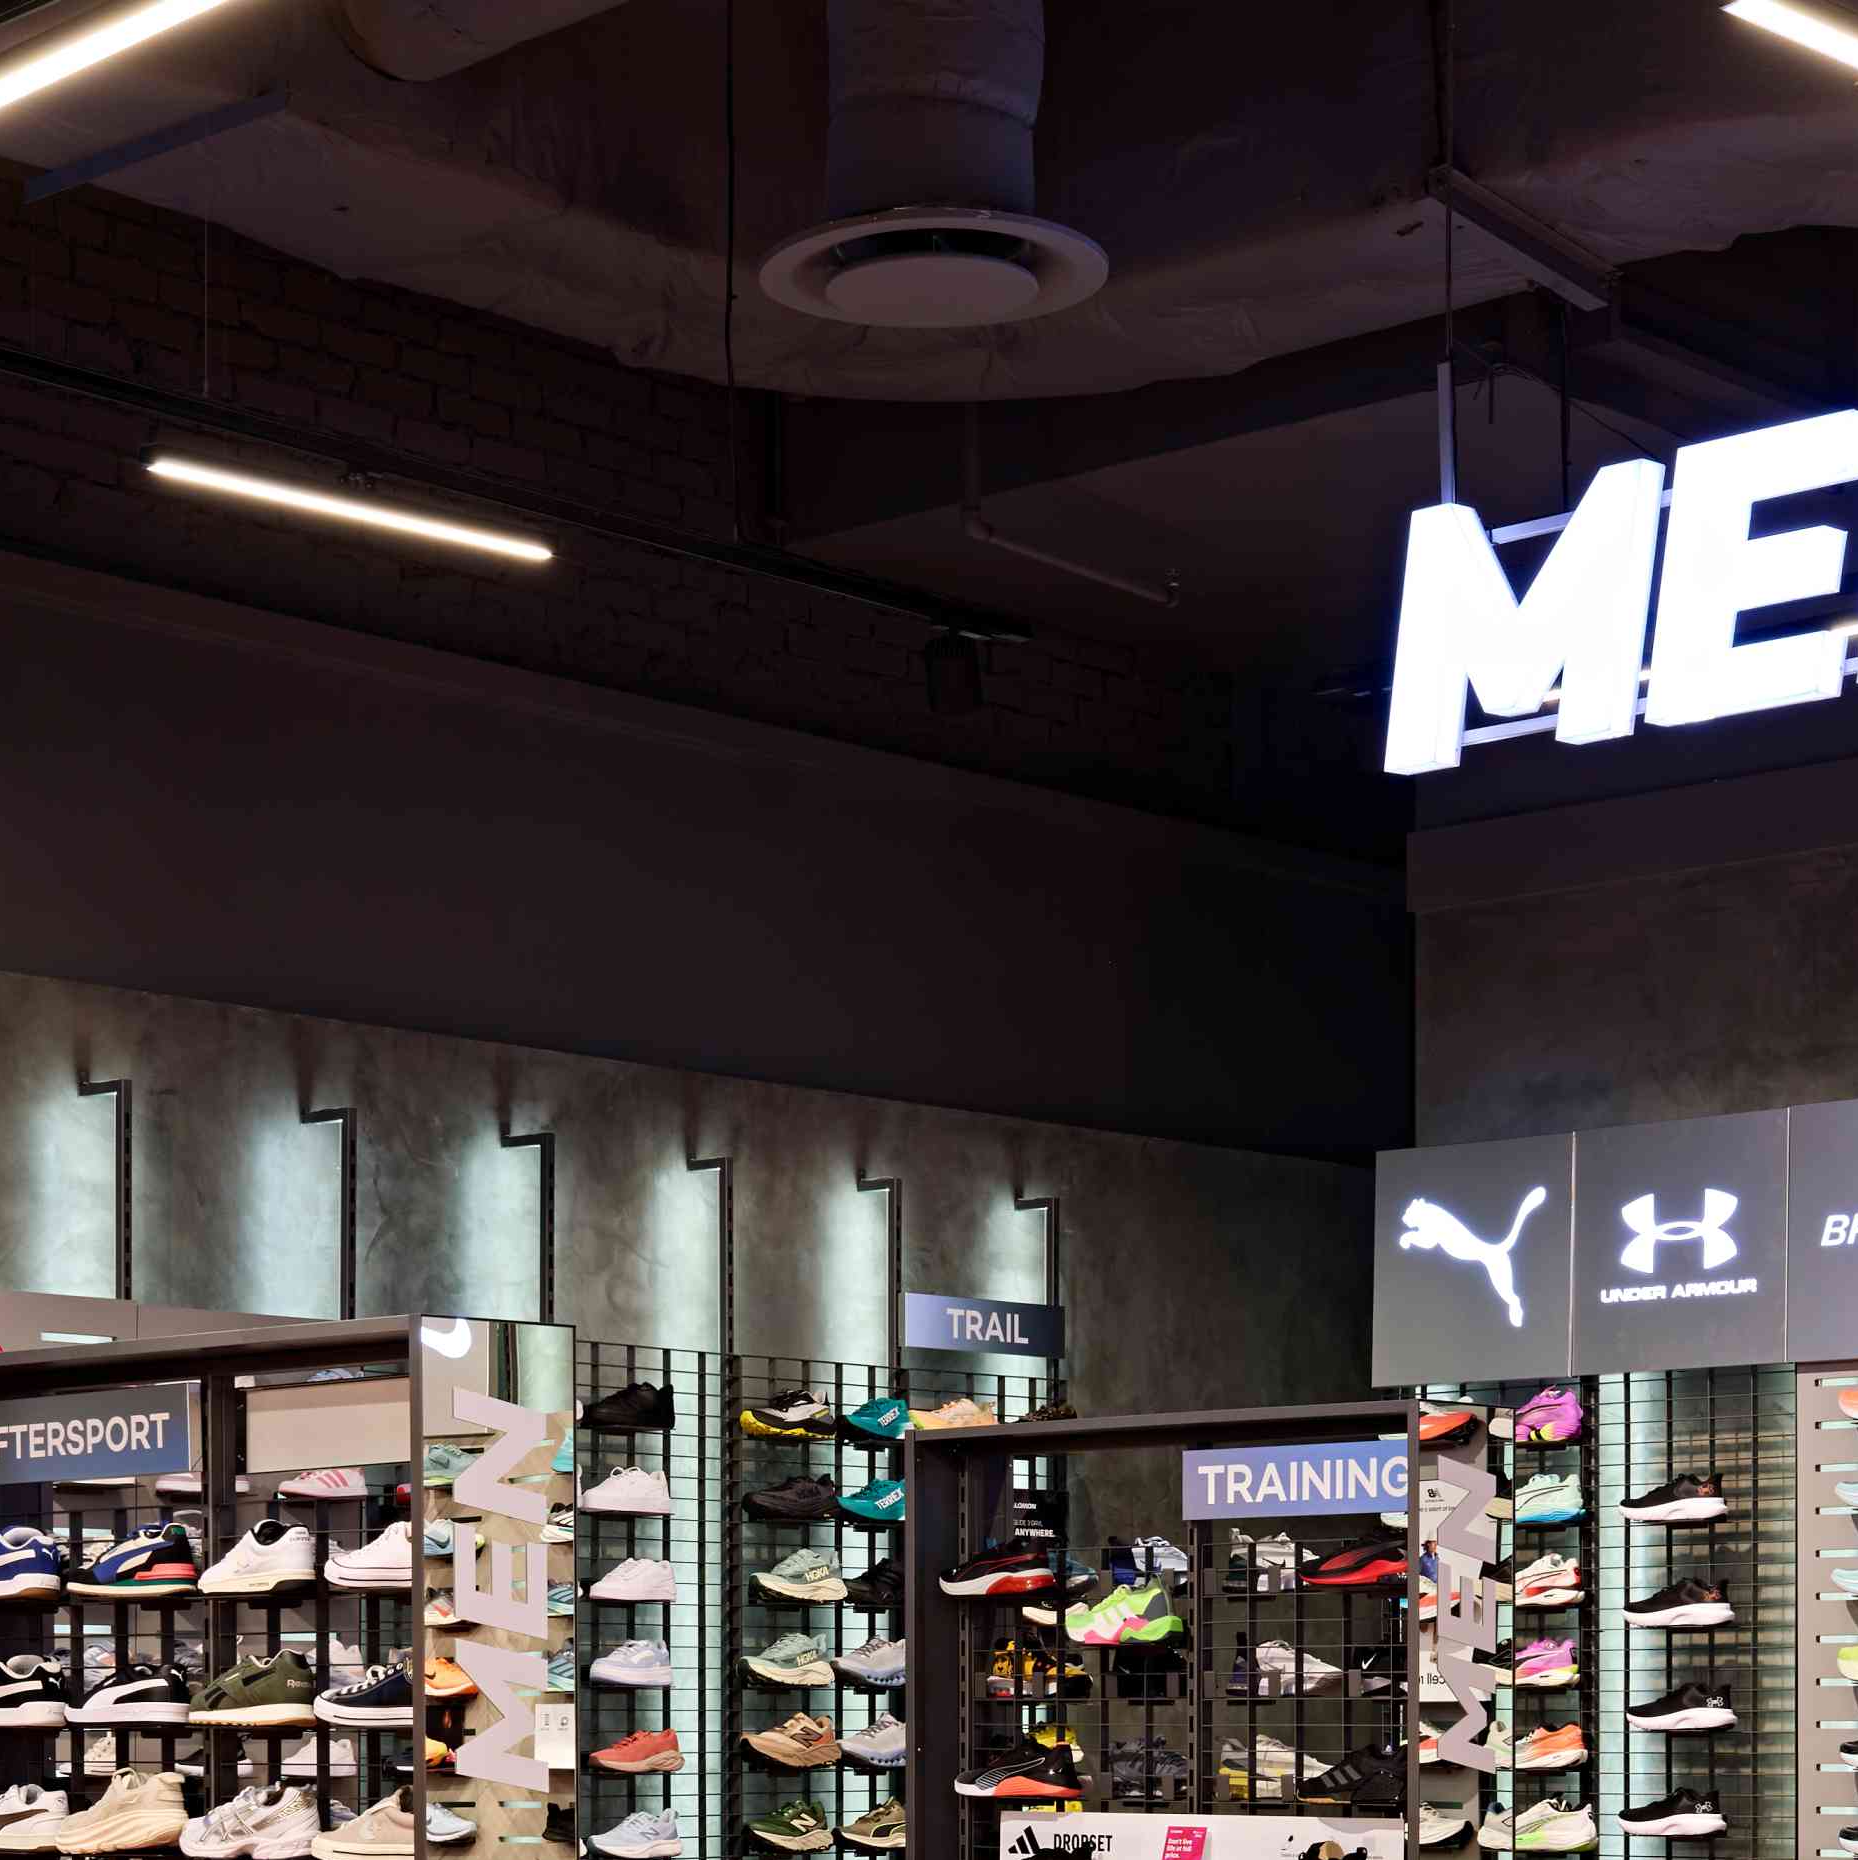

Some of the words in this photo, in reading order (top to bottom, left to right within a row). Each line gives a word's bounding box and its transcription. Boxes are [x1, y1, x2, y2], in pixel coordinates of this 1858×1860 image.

[1600, 1285, 1667, 1303] UNDER
[1671, 1278, 1758, 1298] ARMOUR
[946, 1307, 1029, 1345] TRAIL
[1197, 1454, 1408, 1505] TRAINING
[453, 1385, 549, 1793] MEN
[804, 1565, 830, 1582] HOKA
[1437, 1454, 1497, 1775] MEN
